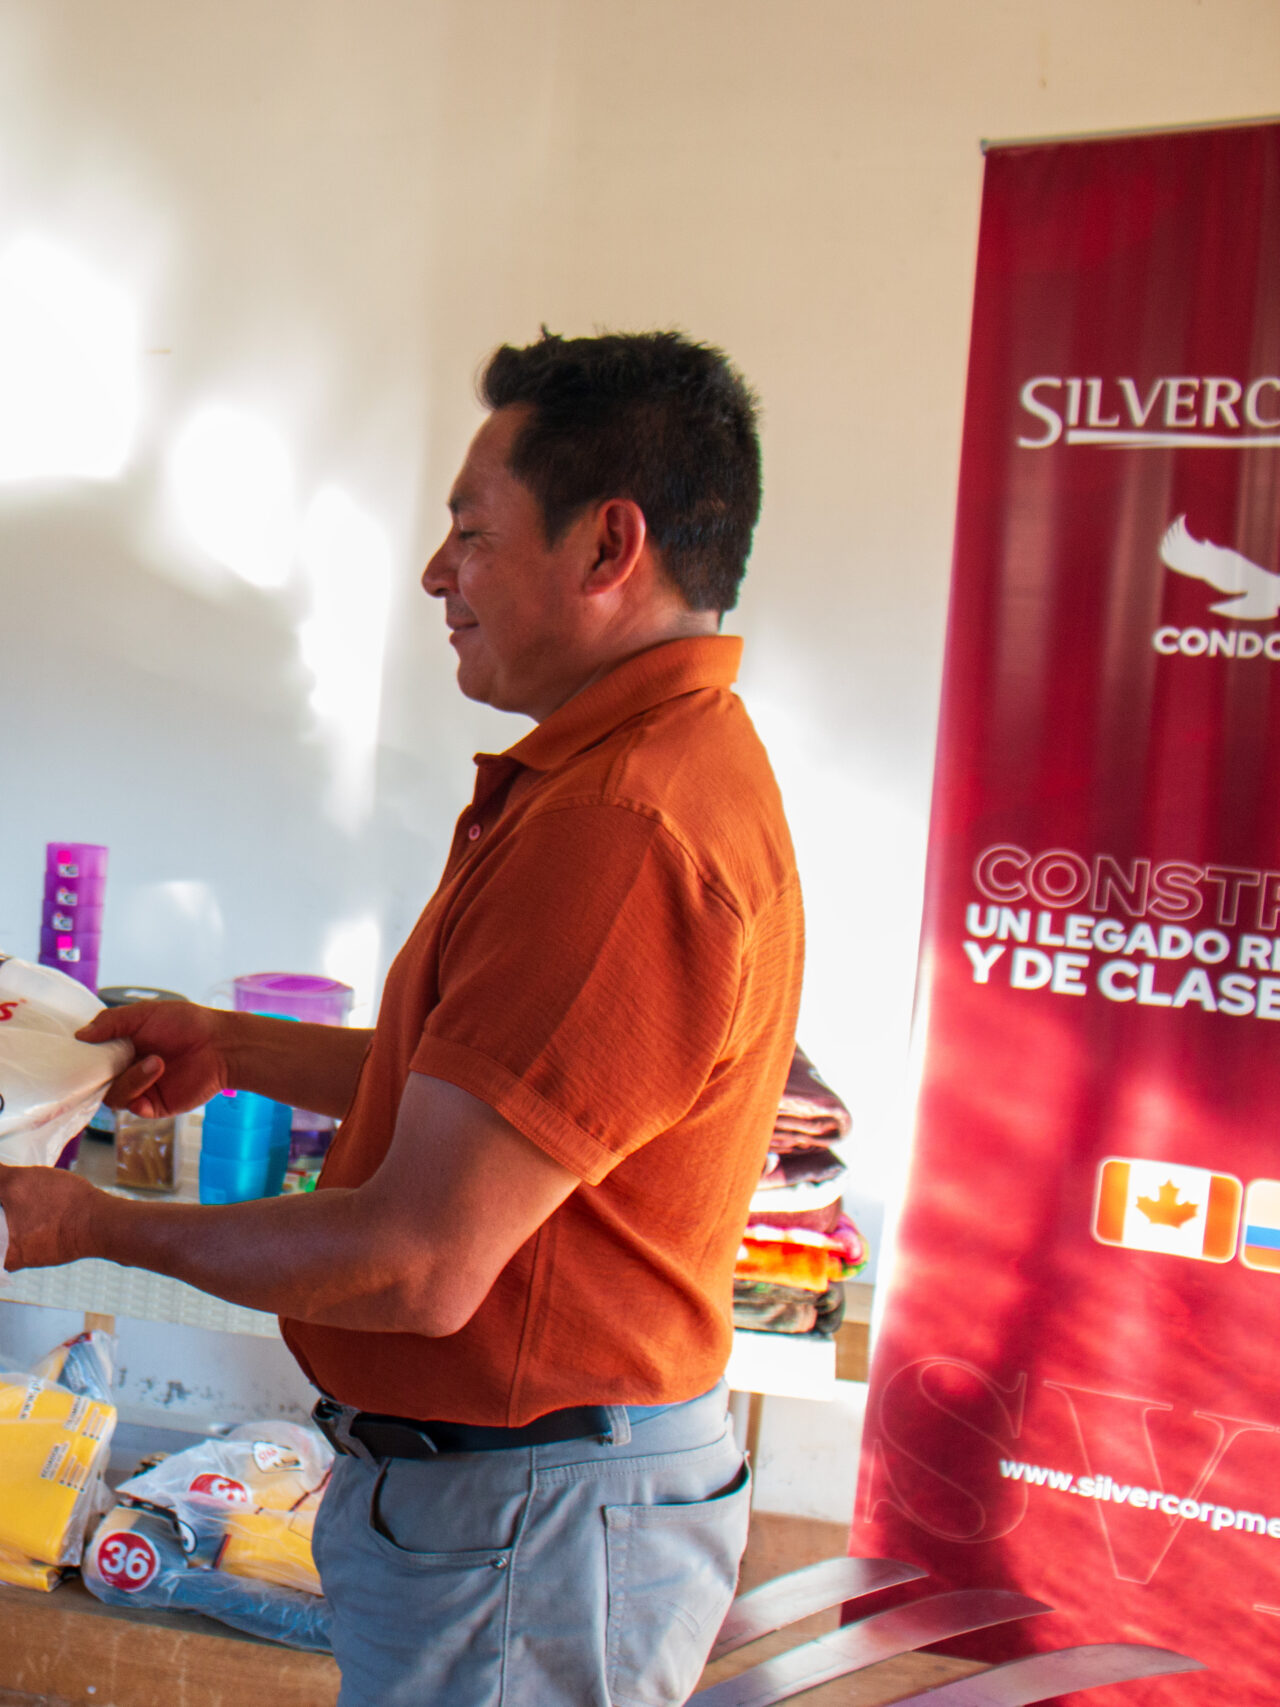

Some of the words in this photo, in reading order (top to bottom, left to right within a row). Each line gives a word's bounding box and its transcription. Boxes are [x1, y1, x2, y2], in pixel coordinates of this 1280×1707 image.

[965, 903, 1030, 941] UN
[1036, 912, 1230, 964] LEGADO
[962, 942, 1003, 984] Y
[1010, 948, 1087, 996] DE
[1097, 960, 1280, 1021] CLASE
[864, 1355, 1280, 1585] SV
[101, 1540, 151, 1580] 36
